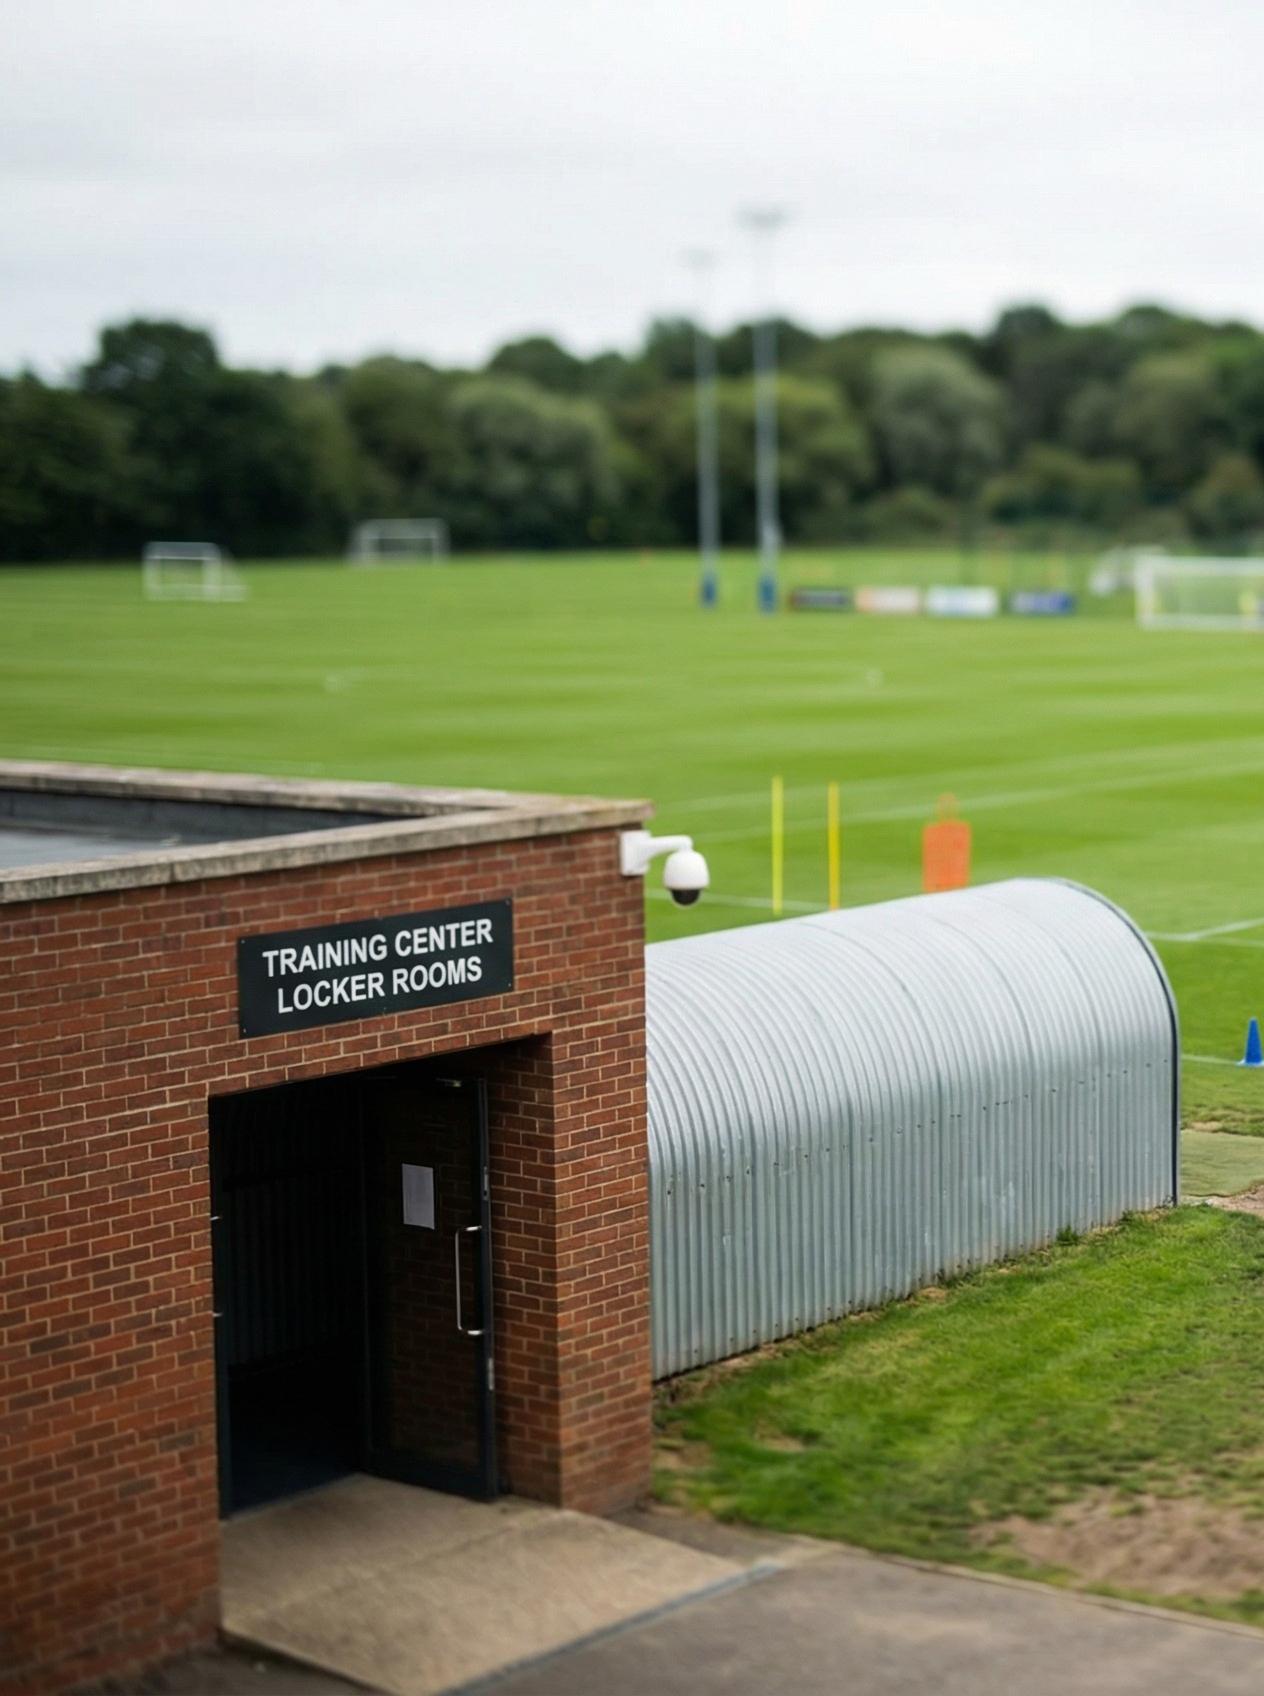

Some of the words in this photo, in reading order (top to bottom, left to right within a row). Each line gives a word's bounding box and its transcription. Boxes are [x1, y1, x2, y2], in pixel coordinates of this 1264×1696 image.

[262, 934, 388, 977] TRAINING
[394, 918, 494, 957] CENTER
[277, 972, 385, 1014] LOCKER
[392, 956, 483, 995] ROOMS
